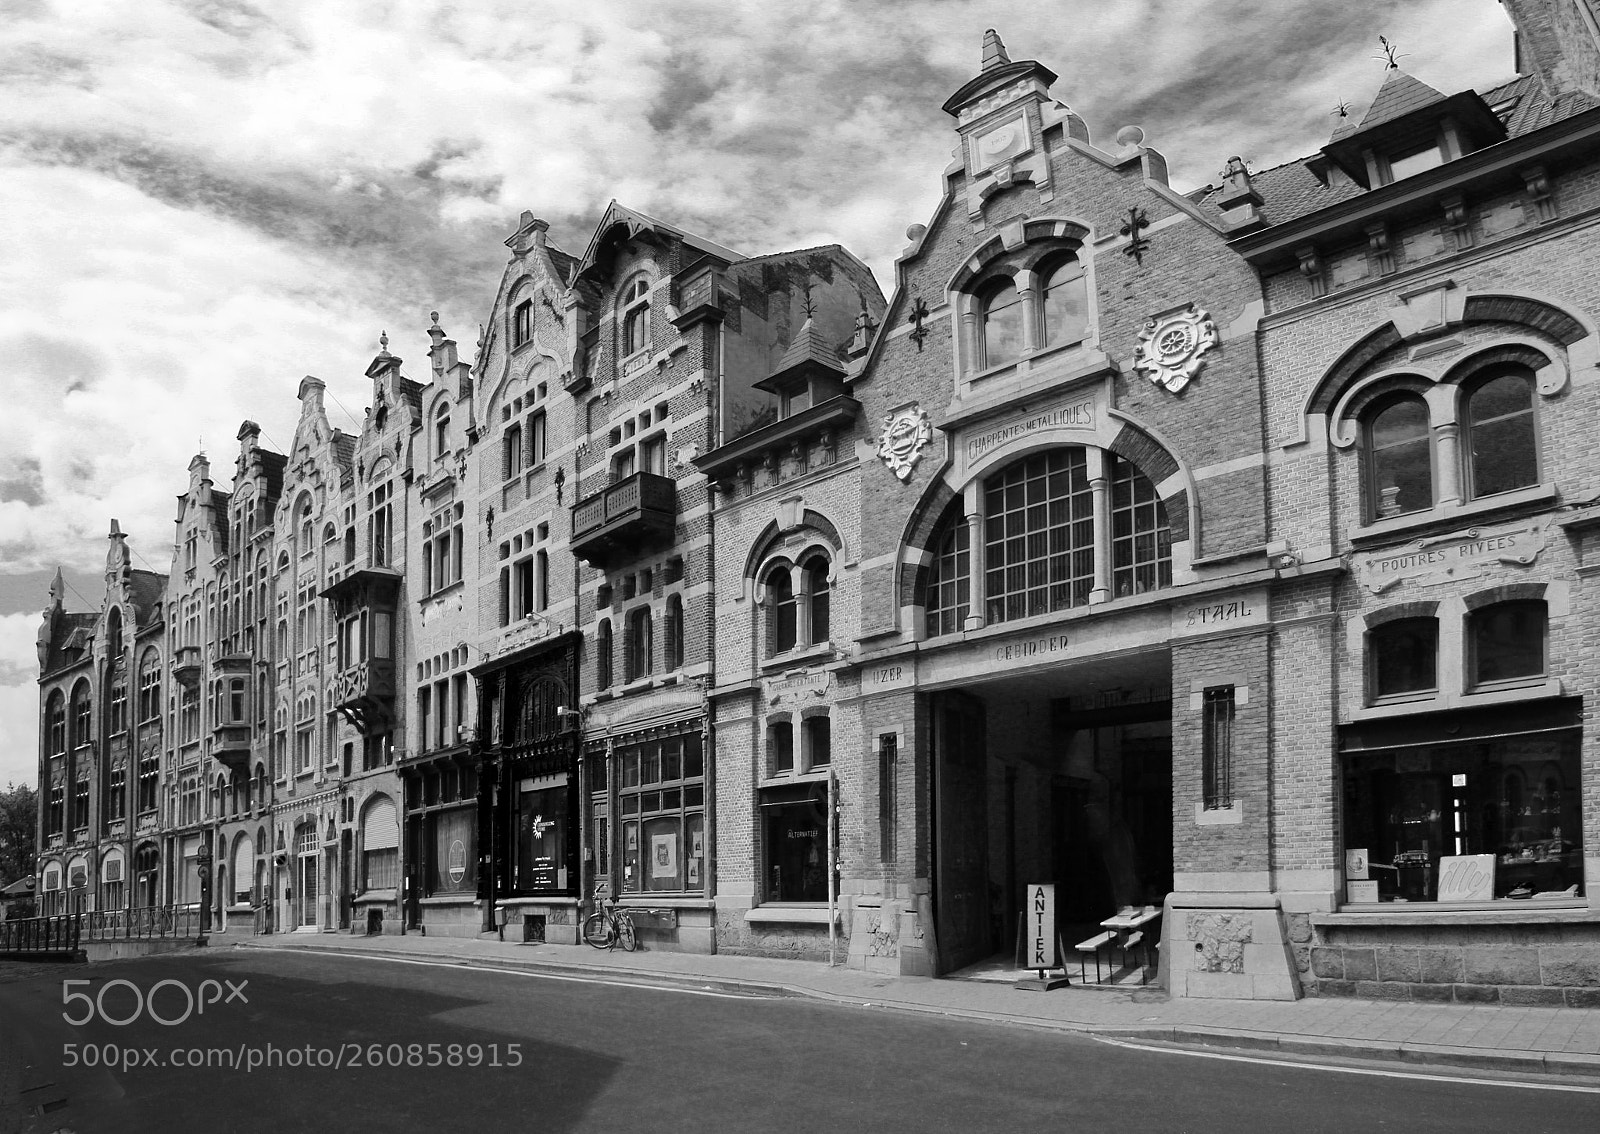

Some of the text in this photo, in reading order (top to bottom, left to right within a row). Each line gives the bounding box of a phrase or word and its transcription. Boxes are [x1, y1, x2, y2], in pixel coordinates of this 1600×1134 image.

[968, 402, 1092, 460] CHARPENTES METALLIQUES
[1381, 535, 1517, 573] POUTRES RIVEES
[1185, 600, 1252, 628] STAAL
[1439, 860, 1491, 899] illy
[1035, 887, 1045, 963] ANTIEK
